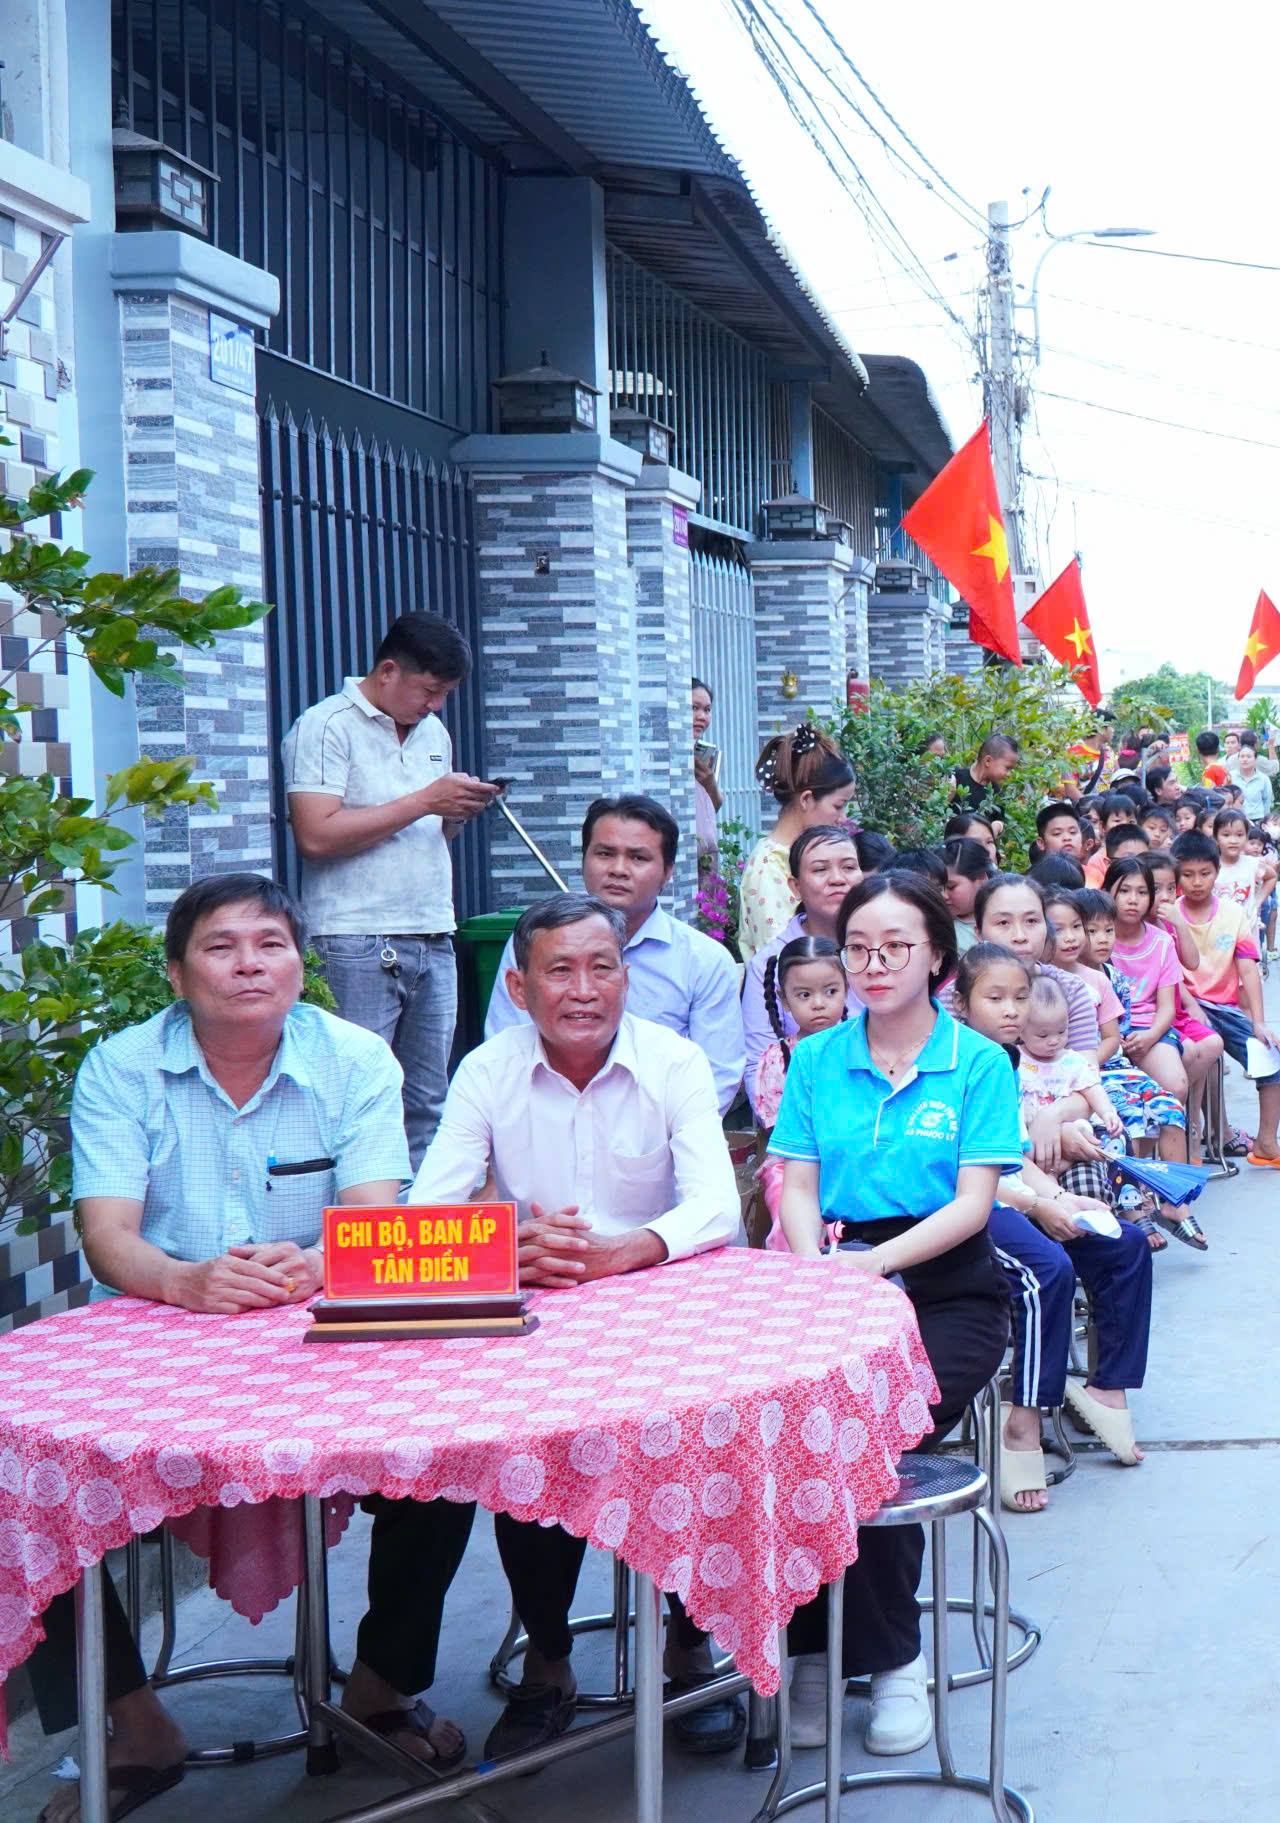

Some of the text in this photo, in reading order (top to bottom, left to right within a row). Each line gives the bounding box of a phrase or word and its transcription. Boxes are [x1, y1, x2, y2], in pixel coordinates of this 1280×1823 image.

[336, 1210, 497, 1251] CHI BỘ, BAN ẤP
[372, 1253, 413, 1284] TÂN
